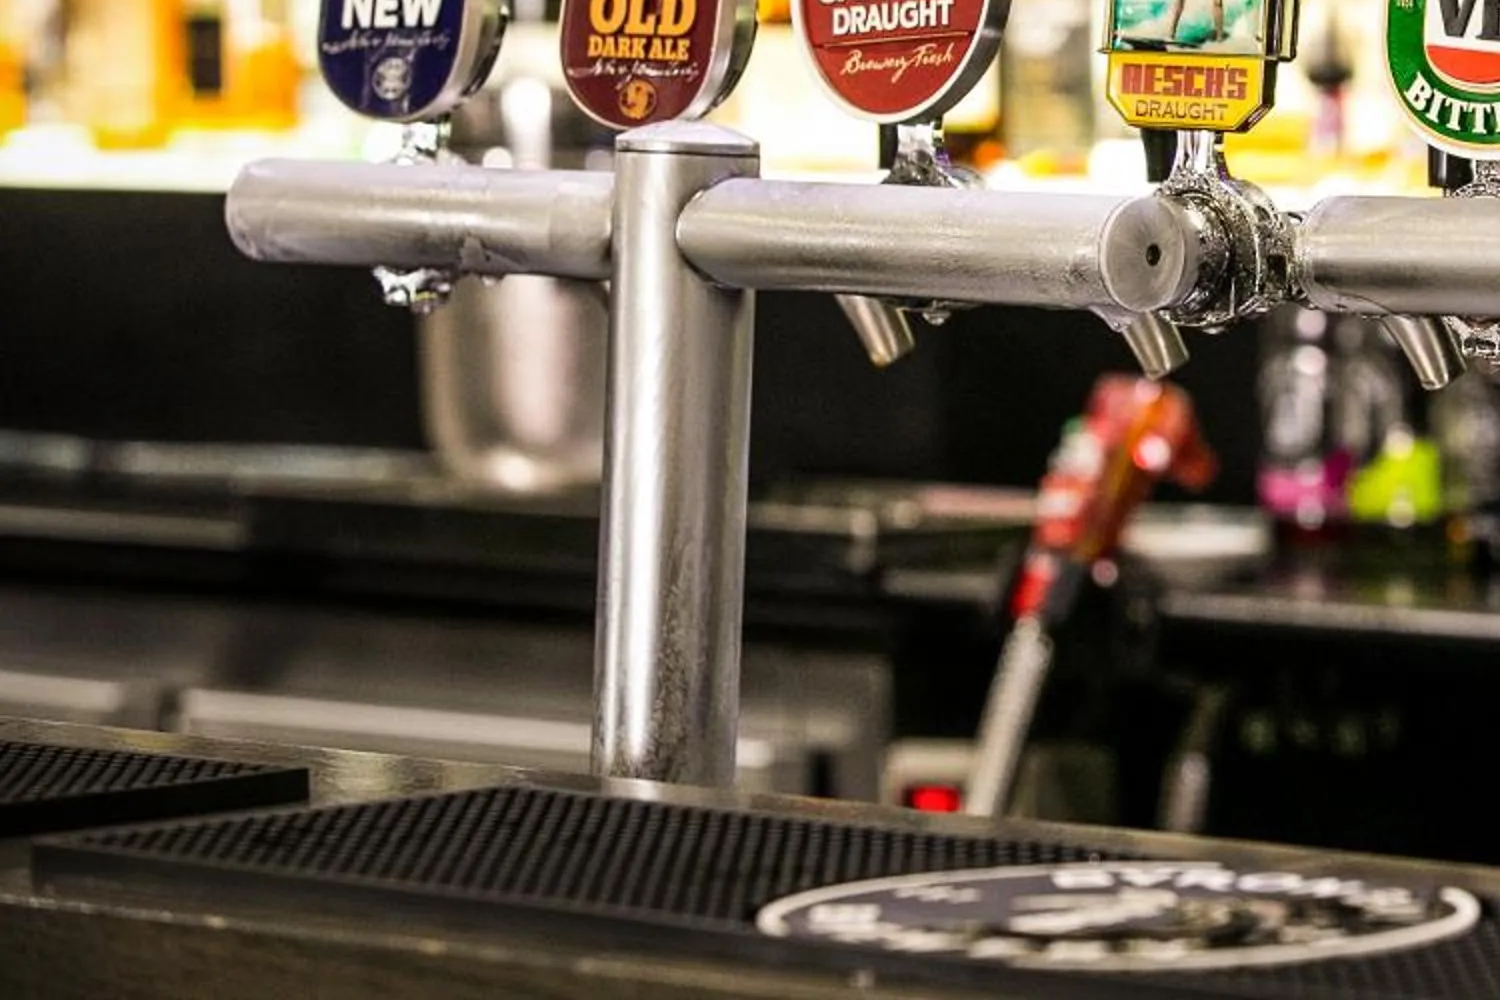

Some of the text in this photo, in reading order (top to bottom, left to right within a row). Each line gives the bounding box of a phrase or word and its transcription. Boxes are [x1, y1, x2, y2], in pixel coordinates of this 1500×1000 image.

[587, 35, 691, 62] DARK ALE
[841, 42, 954, 84] Brewery Fresh
[1135, 99, 1230, 122] DRAUGHT
